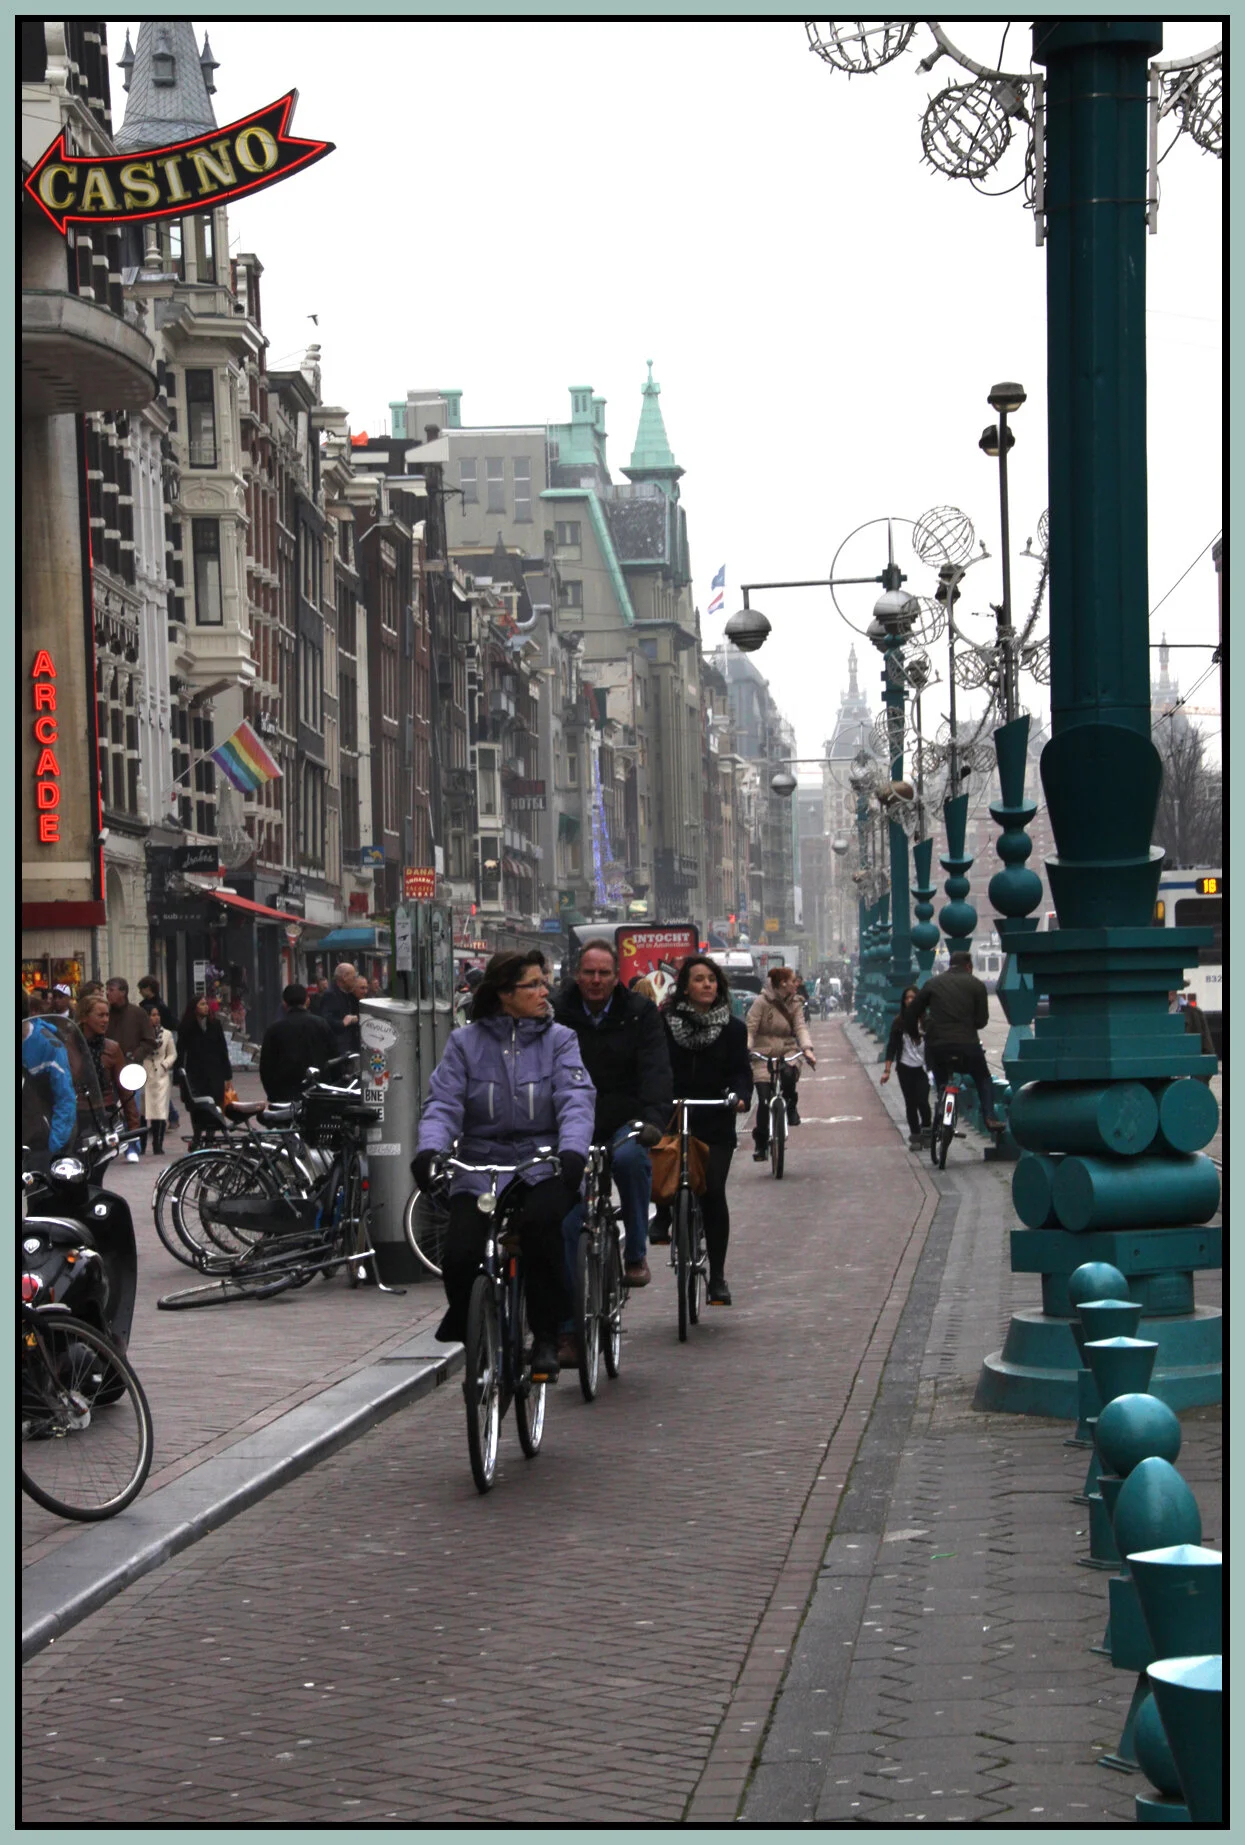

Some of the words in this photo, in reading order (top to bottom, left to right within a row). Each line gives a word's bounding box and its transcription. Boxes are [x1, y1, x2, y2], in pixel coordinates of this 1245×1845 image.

[39, 126, 279, 212] CASINO
[32, 649, 60, 843] ARCADE
[511, 798, 545, 810] HOTEL
[365, 1090, 383, 1101] BNE
